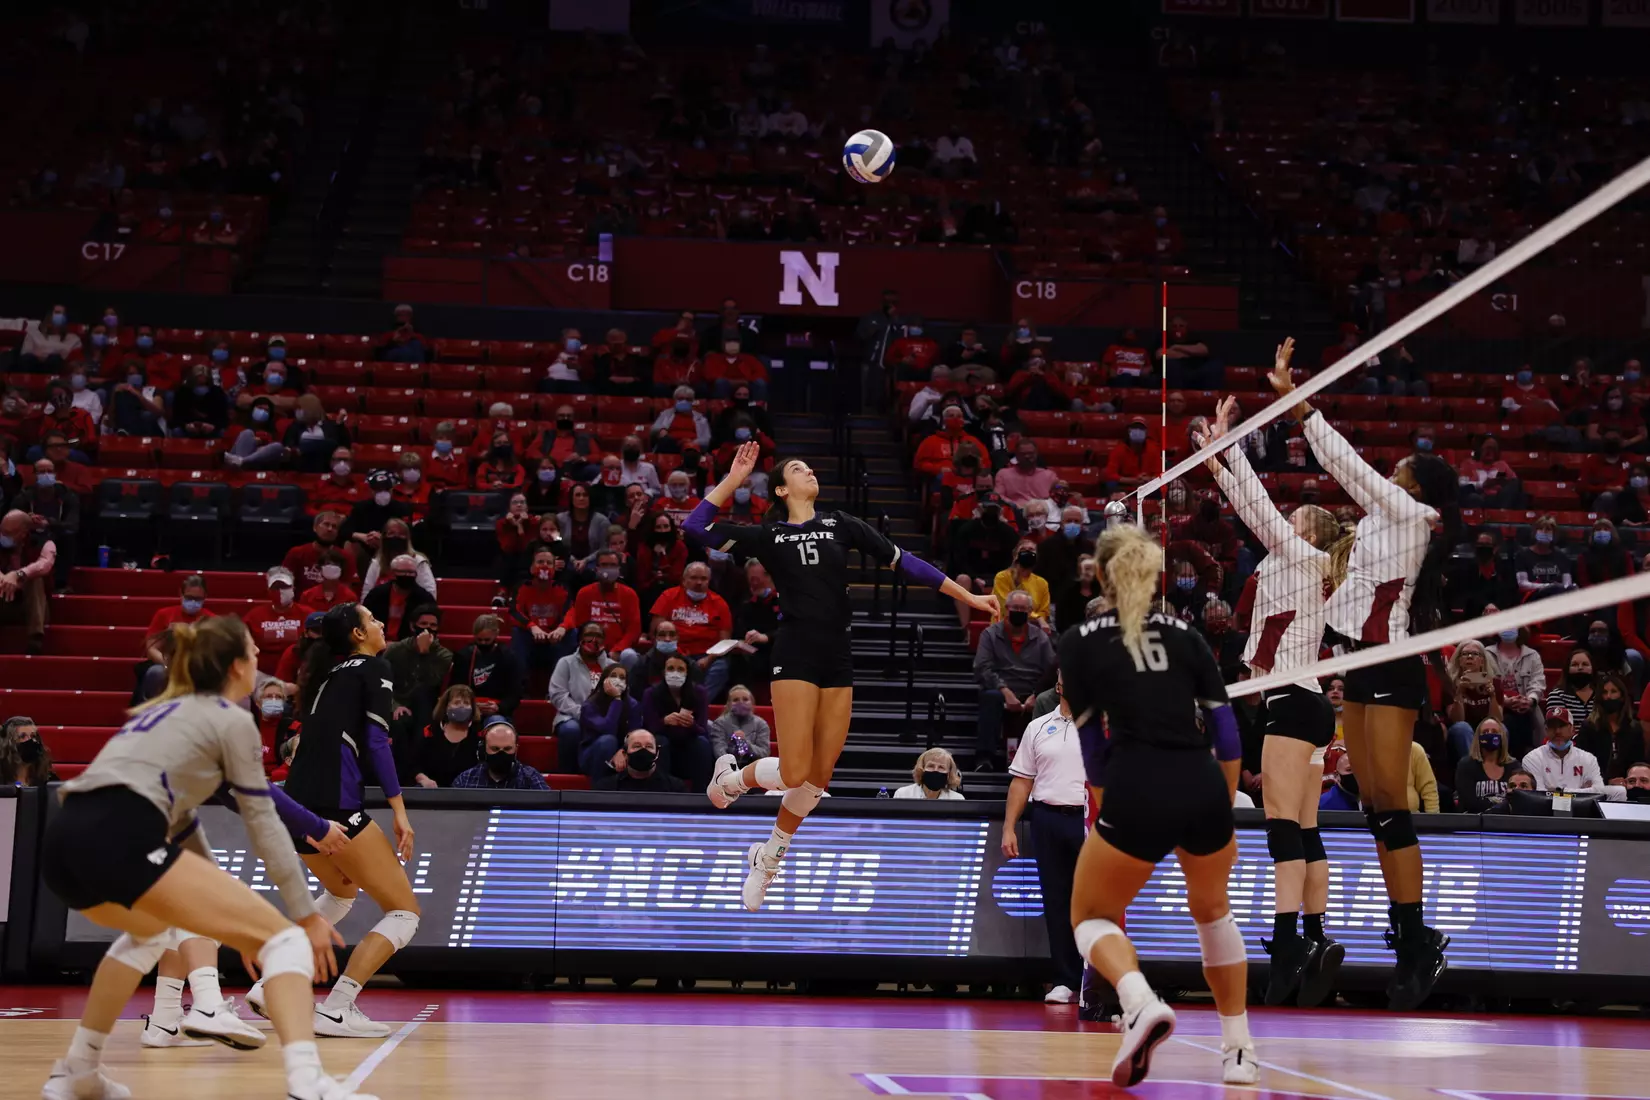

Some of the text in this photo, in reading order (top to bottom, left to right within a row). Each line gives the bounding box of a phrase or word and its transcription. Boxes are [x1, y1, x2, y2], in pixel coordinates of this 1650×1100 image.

[81, 241, 126, 261] C17
[567, 264, 609, 283] C18
[779, 250, 840, 306] N
[1016, 281, 1057, 300] C18
[774, 531, 835, 544] K-STATE
[796, 541, 820, 566] 15
[1079, 612, 1189, 637] WILATS
[1122, 630, 1169, 673] 16
[1573, 765, 1584, 777] N
[549, 847, 880, 912] #NCAVB
